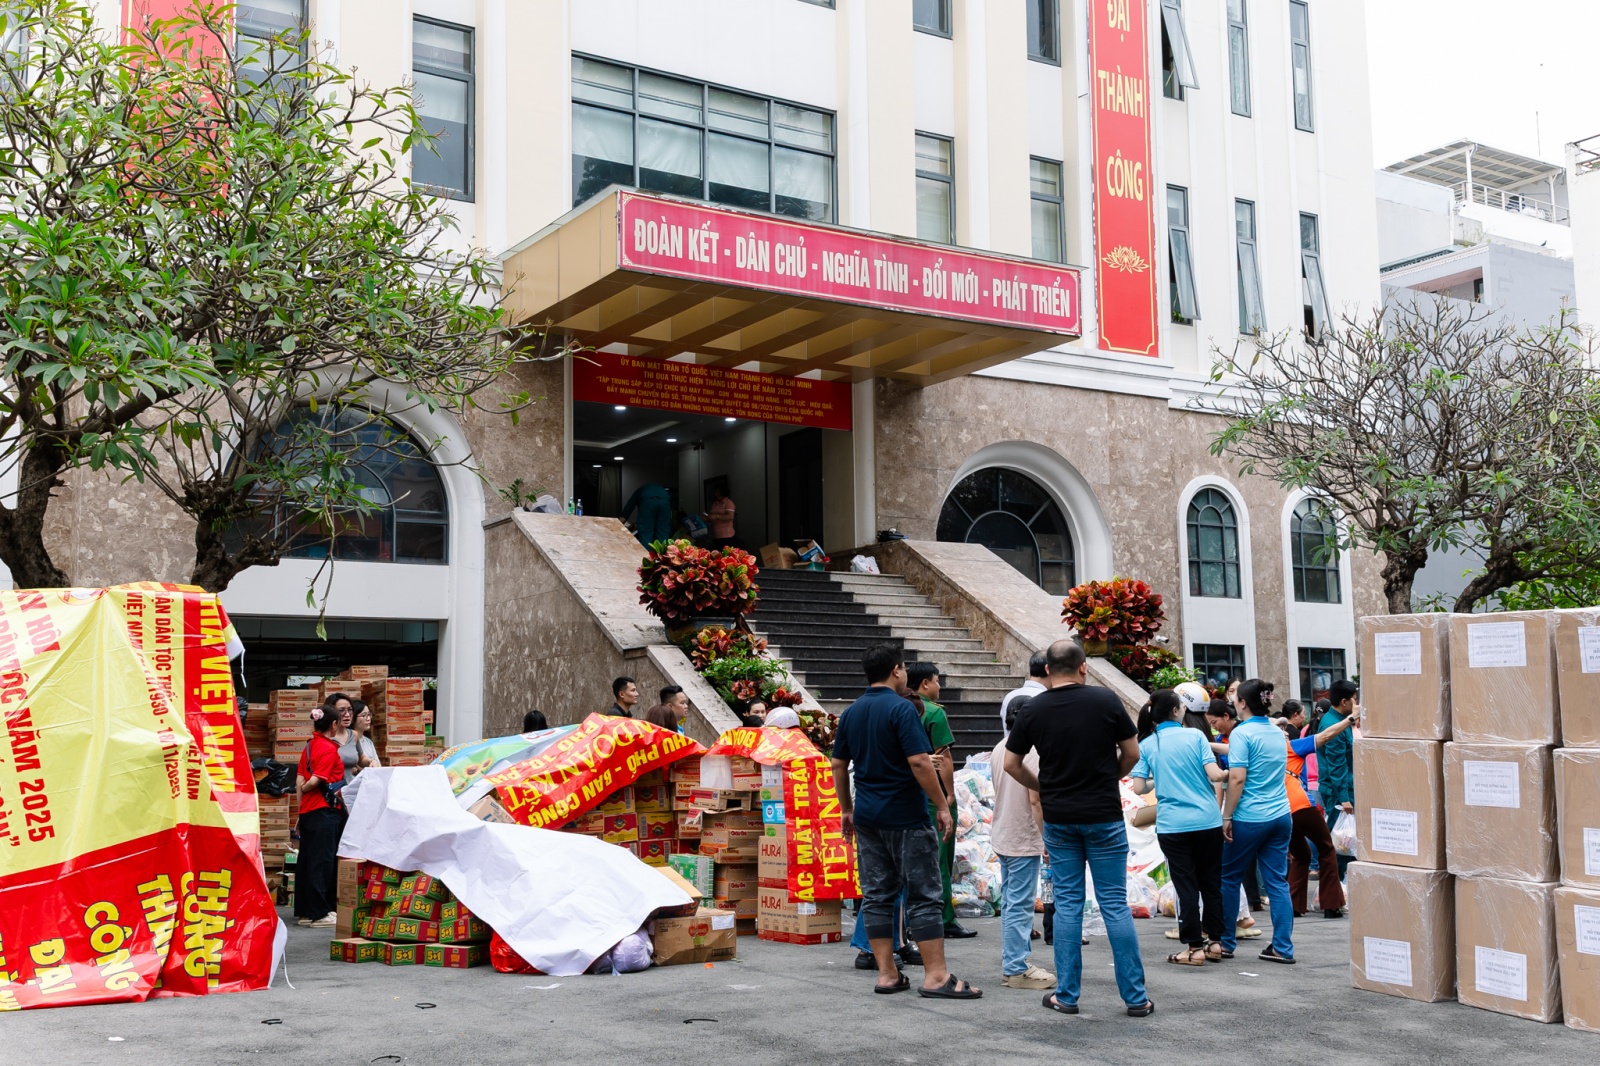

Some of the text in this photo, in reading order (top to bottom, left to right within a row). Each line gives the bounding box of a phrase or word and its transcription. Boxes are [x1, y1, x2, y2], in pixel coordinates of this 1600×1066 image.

[1107, 0, 1130, 42] ĐẠI
[1098, 66, 1144, 118] THÀNH
[1106, 149, 1144, 202] CÔNG
[634, 216, 683, 258] ĐOÀN
[688, 220, 719, 264] KẾT
[736, 232, 770, 272] DÂN
[775, 236, 807, 278] CHỦ
[822, 249, 870, 288] NGHĨA
[874, 254, 909, 294] TÌNH
[922, 258, 947, 300] ĐỔI
[951, 268, 979, 304] MỚI
[992, 275, 1027, 311] PHÁT
[1031, 276, 1070, 317] TRIỂN
[620, 357, 629, 366] ỦY
[632, 359, 645, 368] BAN
[663, 363, 679, 372] TRẬN
[681, 364, 690, 373] TỔ
[691, 366, 708, 376] QUỐC
[710, 369, 722, 378] VIỆT
[725, 371, 739, 380] NAM
[741, 372, 760, 382] THÀNH
[762, 375, 774, 385] PHỐ
[775, 377, 784, 386] HỒ
[785, 378, 796, 387] CHÍ
[656, 372, 668, 380] ĐUA
[671, 374, 687, 383] THỰC
[689, 376, 703, 386] HIỆN
[705, 377, 726, 388] THẮNG
[727, 381, 737, 390] LỢI
[739, 382, 751, 391] CHỦ
[762, 385, 776, 394] NĂM
[123, 592, 146, 617] VIỆT
[26, 614, 61, 654] HỘI
[127, 621, 144, 649] NAM
[155, 618, 174, 644] DÂN
[152, 648, 174, 671] TỘC
[5, 707, 41, 772] NĂM
[193, 655, 235, 793] VIỆT NAM
[557, 720, 599, 755] PHỐ
[555, 722, 635, 784] ĐOÀN
[626, 745, 659, 778] PHỐ
[186, 768, 201, 800] NAM
[502, 768, 558, 812] KẾT
[582, 769, 613, 798] BAN
[791, 757, 811, 810] TRẬN
[19, 778, 55, 842] 2025
[527, 792, 579, 829] CÔNG
[761, 844, 781, 858] HURA
[793, 817, 814, 864] MẶT
[402, 880, 415, 890] 5+1
[414, 900, 431, 913] 5+1
[443, 908, 455, 918] 5+1
[761, 896, 781, 910] HURA
[398, 923, 417, 934] 5+1
[441, 926, 452, 938] 5+1
[84, 901, 140, 991] CÔNG
[360, 947, 376, 958] 5+1
[395, 950, 413, 960] 5+1
[427, 950, 441, 961] 5+1
[26, 938, 77, 995] ĐẠI
